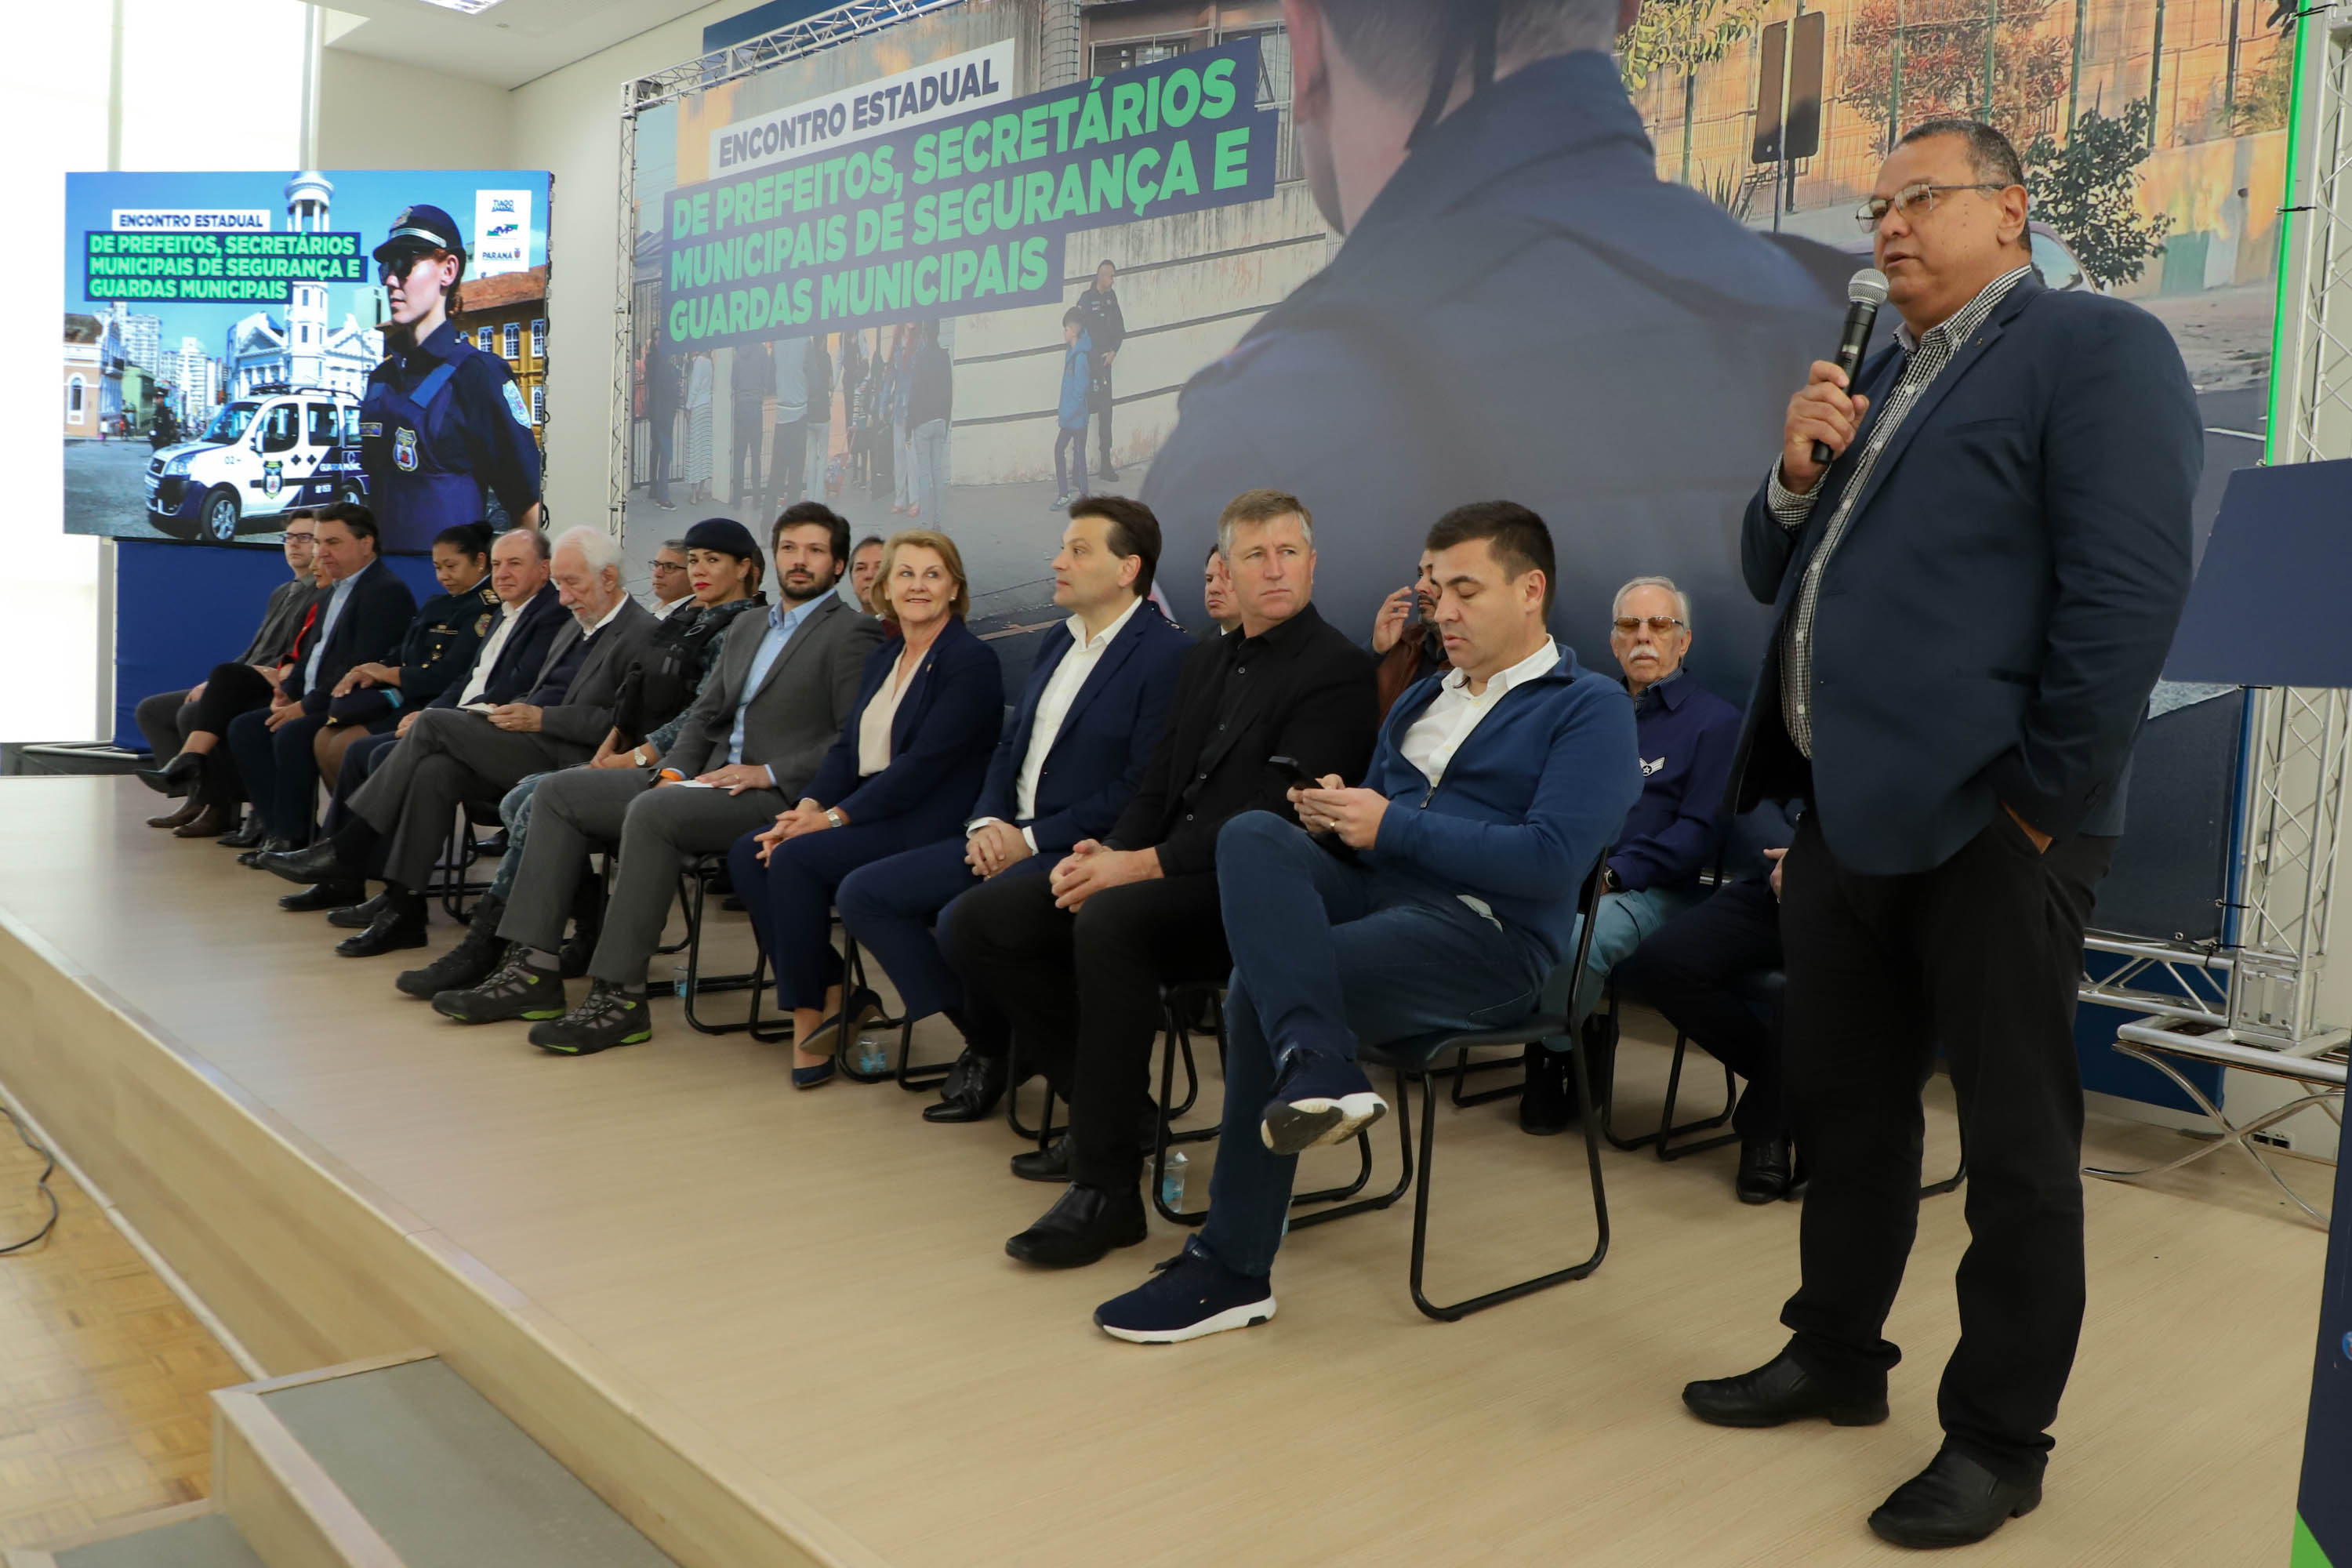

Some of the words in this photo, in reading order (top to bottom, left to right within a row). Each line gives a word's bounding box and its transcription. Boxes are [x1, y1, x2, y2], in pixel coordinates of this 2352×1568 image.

[719, 103, 847, 168] ENCONTRO
[853, 59, 999, 131] ESTADUAL
[673, 192, 710, 241] DE
[716, 145, 903, 230] PREFEITOS,
[912, 58, 1236, 185] SECRETÁRIOS
[120, 215, 191, 227] ENCONTRO
[195, 215, 263, 227] ESTADUAL
[670, 214, 848, 292] MUNICIPAIS
[856, 201, 906, 256] DE
[911, 139, 1200, 245] SEGURANÇA
[1214, 126, 1250, 191] E
[89, 235, 116, 253] DE
[118, 235, 223, 257] PREFEITOS,
[224, 231, 356, 255] SECRETÁRIOS
[89, 256, 194, 276] MUNICIPAIS
[198, 258, 223, 277] DE
[225, 258, 344, 281] SEGURANÇA
[347, 259, 361, 278] E
[89, 279, 177, 297] GUARDAS
[180, 280, 288, 299] MUNICIPAIS
[670, 278, 812, 343] GUARDAS
[820, 236, 1048, 320] MUNICIPAIS
